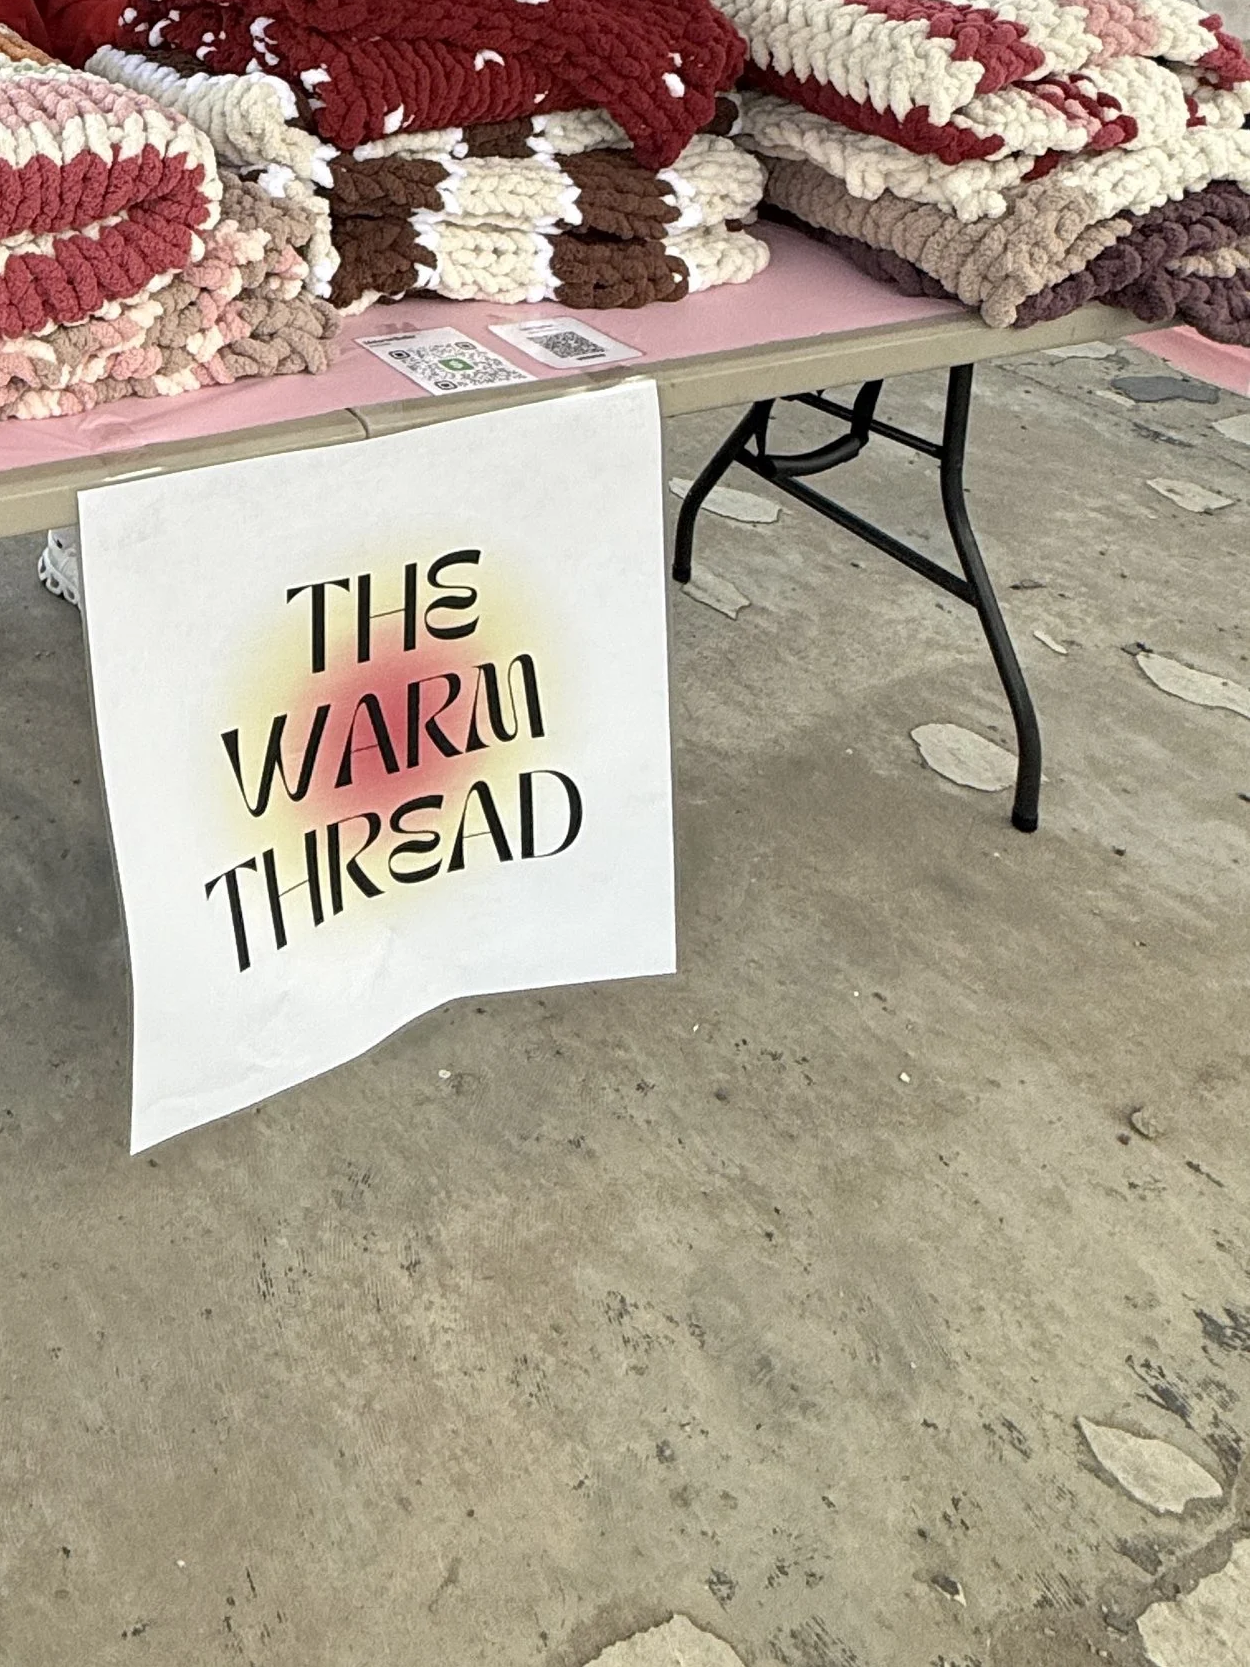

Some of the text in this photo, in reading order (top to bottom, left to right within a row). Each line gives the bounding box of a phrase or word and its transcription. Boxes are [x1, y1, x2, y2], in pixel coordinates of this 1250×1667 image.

[286, 549, 482, 674] THE
[220, 653, 546, 819] WARM
[204, 769, 584, 974] THREAD
